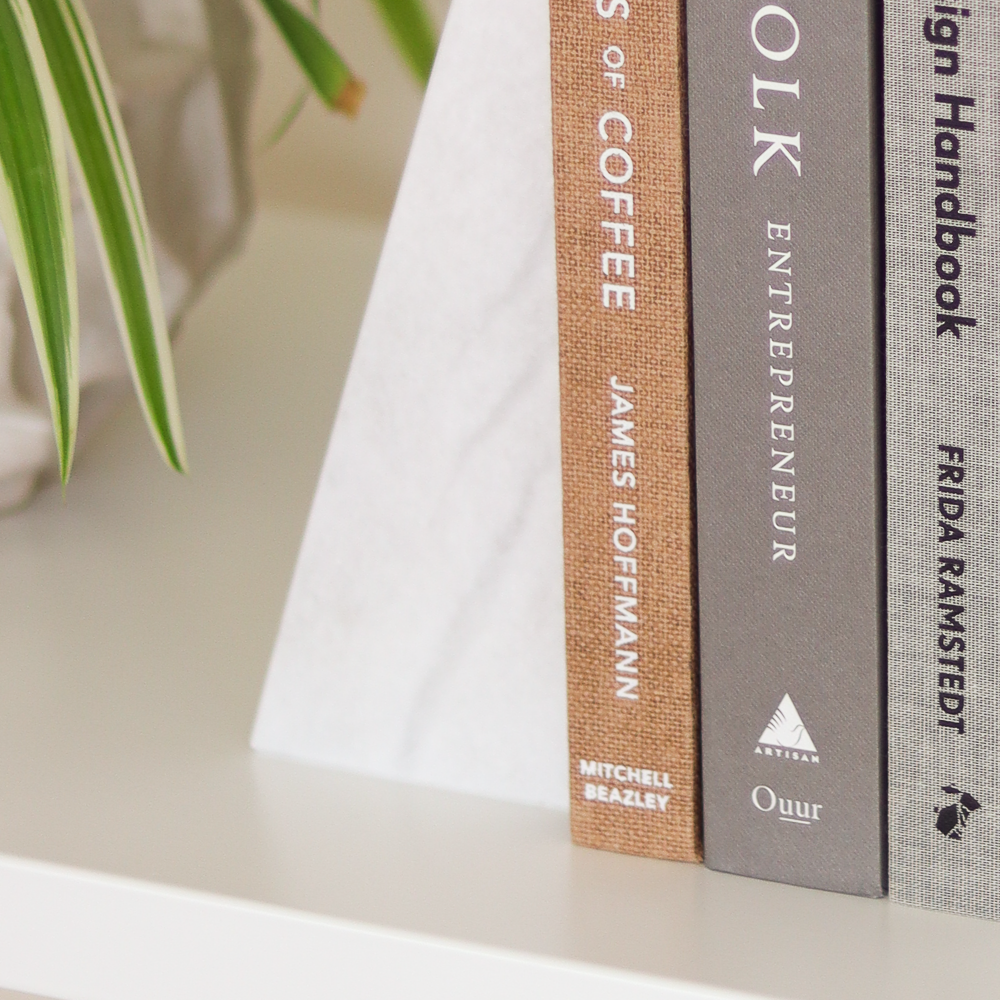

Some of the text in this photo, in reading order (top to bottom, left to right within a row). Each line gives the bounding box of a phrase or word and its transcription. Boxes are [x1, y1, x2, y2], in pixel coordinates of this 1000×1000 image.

[602, 45, 625, 89] OF
[598, 111, 636, 311] COFFEE
[933, 93, 977, 339] Handbook
[766, 219, 797, 563] ENTREPRENEUR
[610, 375, 639, 701] JAMES HOFFMANN
[937, 444, 966, 736] FRIDA RAMSTEDT
[579, 758, 674, 790] MITCHELL
[584, 784, 670, 813] BEAZLEY
[751, 784, 823, 822] Ouur
[753, 745, 820, 764] ARTISAN
